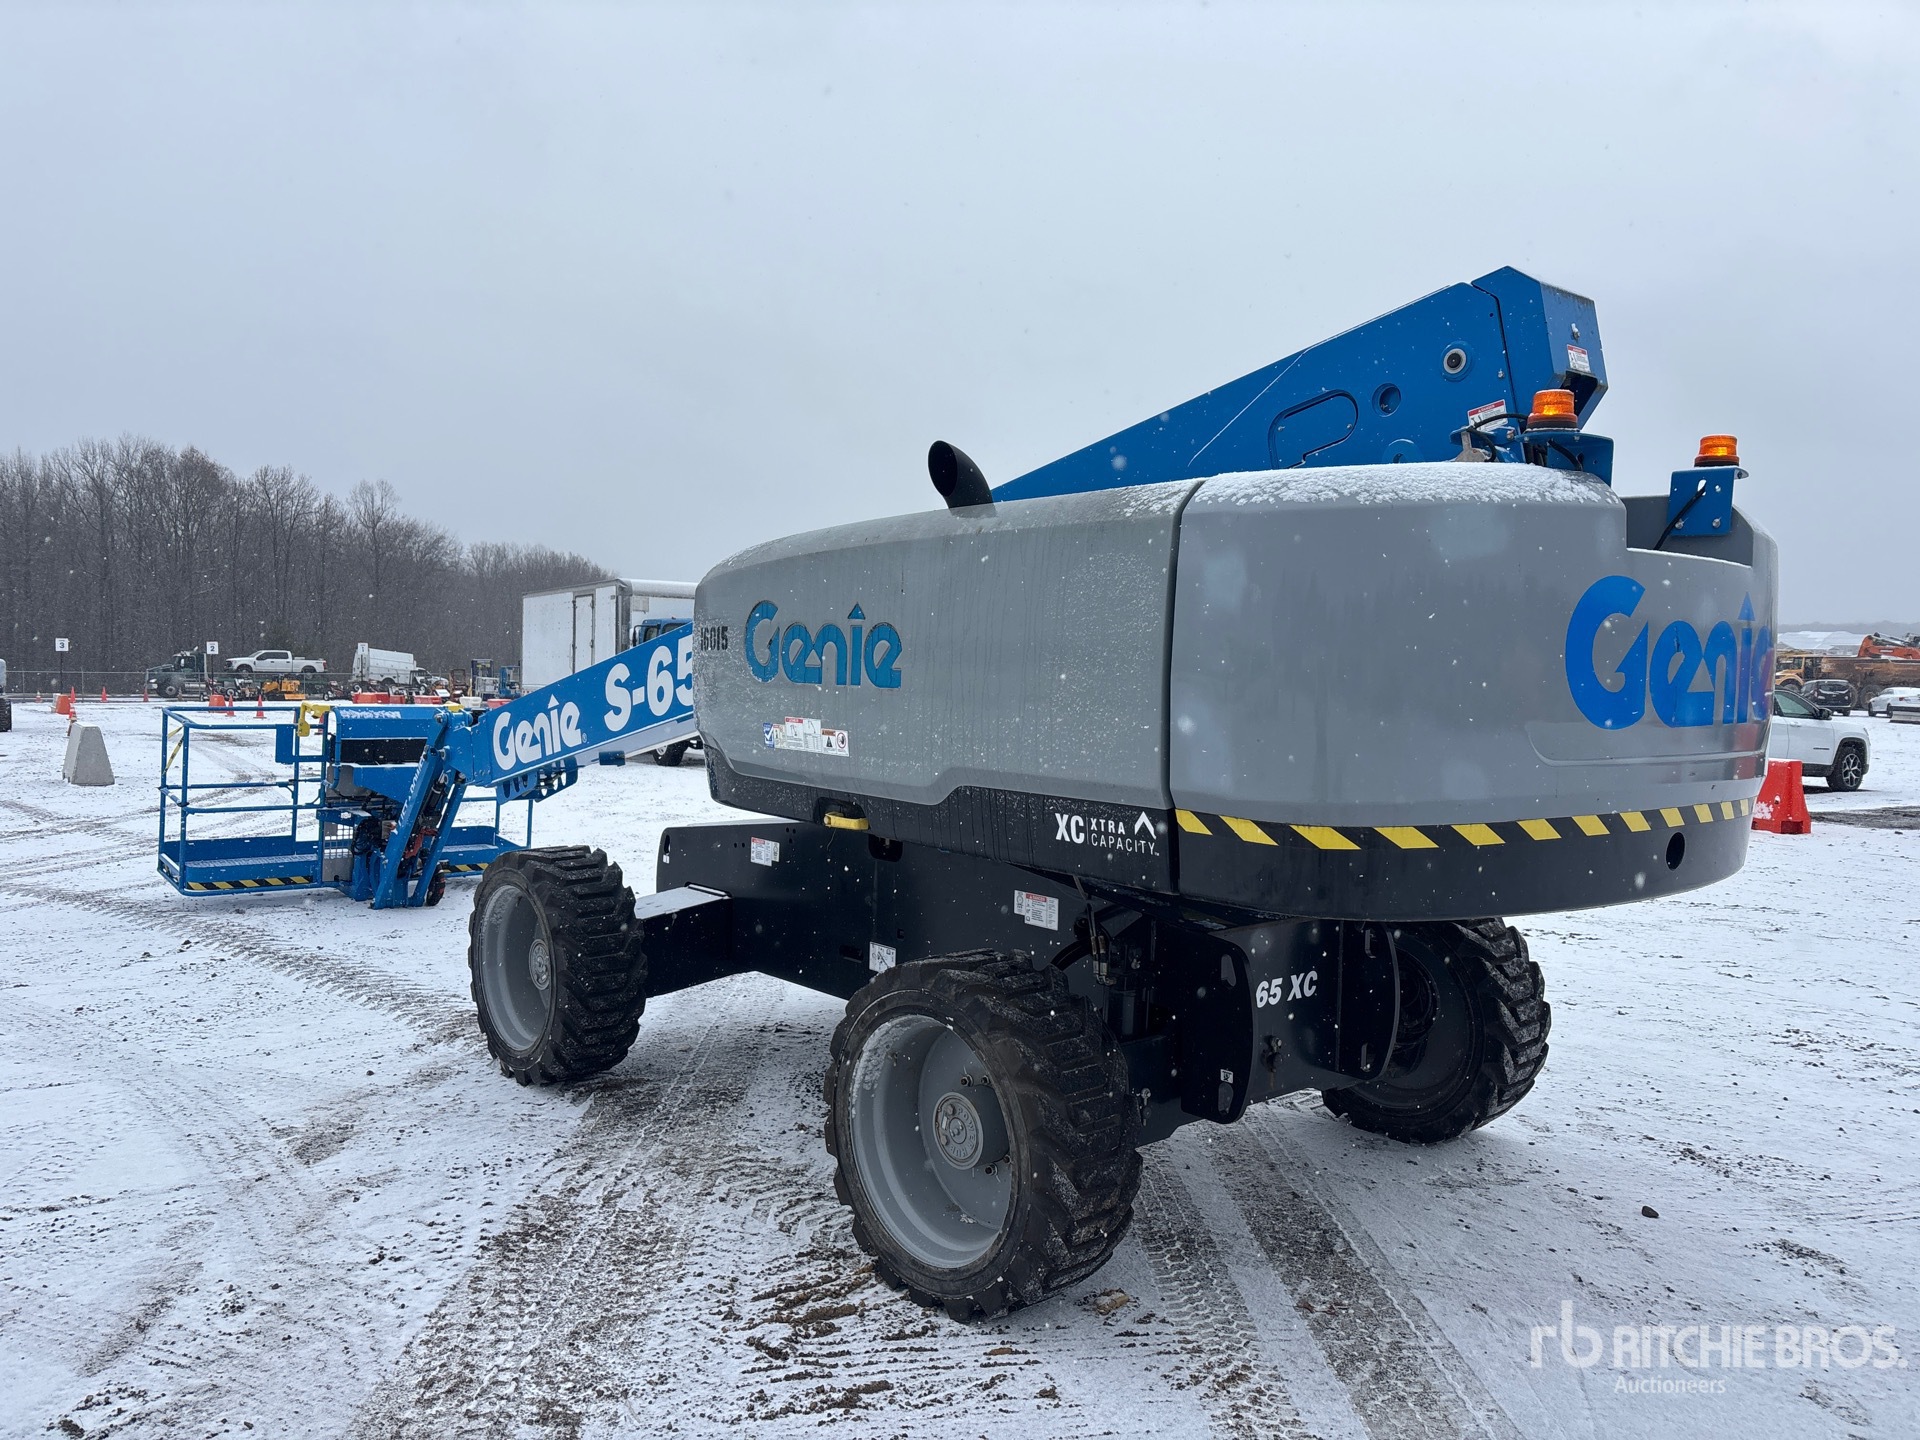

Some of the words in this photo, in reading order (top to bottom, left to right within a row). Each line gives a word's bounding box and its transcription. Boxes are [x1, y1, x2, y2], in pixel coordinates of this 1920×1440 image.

[745, 600, 902, 689] Genie
[493, 694, 582, 770] Genie
[1055, 813, 1085, 844] XC
[1090, 818, 1126, 835] XTRA
[1256, 977, 1283, 1008] 65
[1287, 970, 1318, 1001] XC
